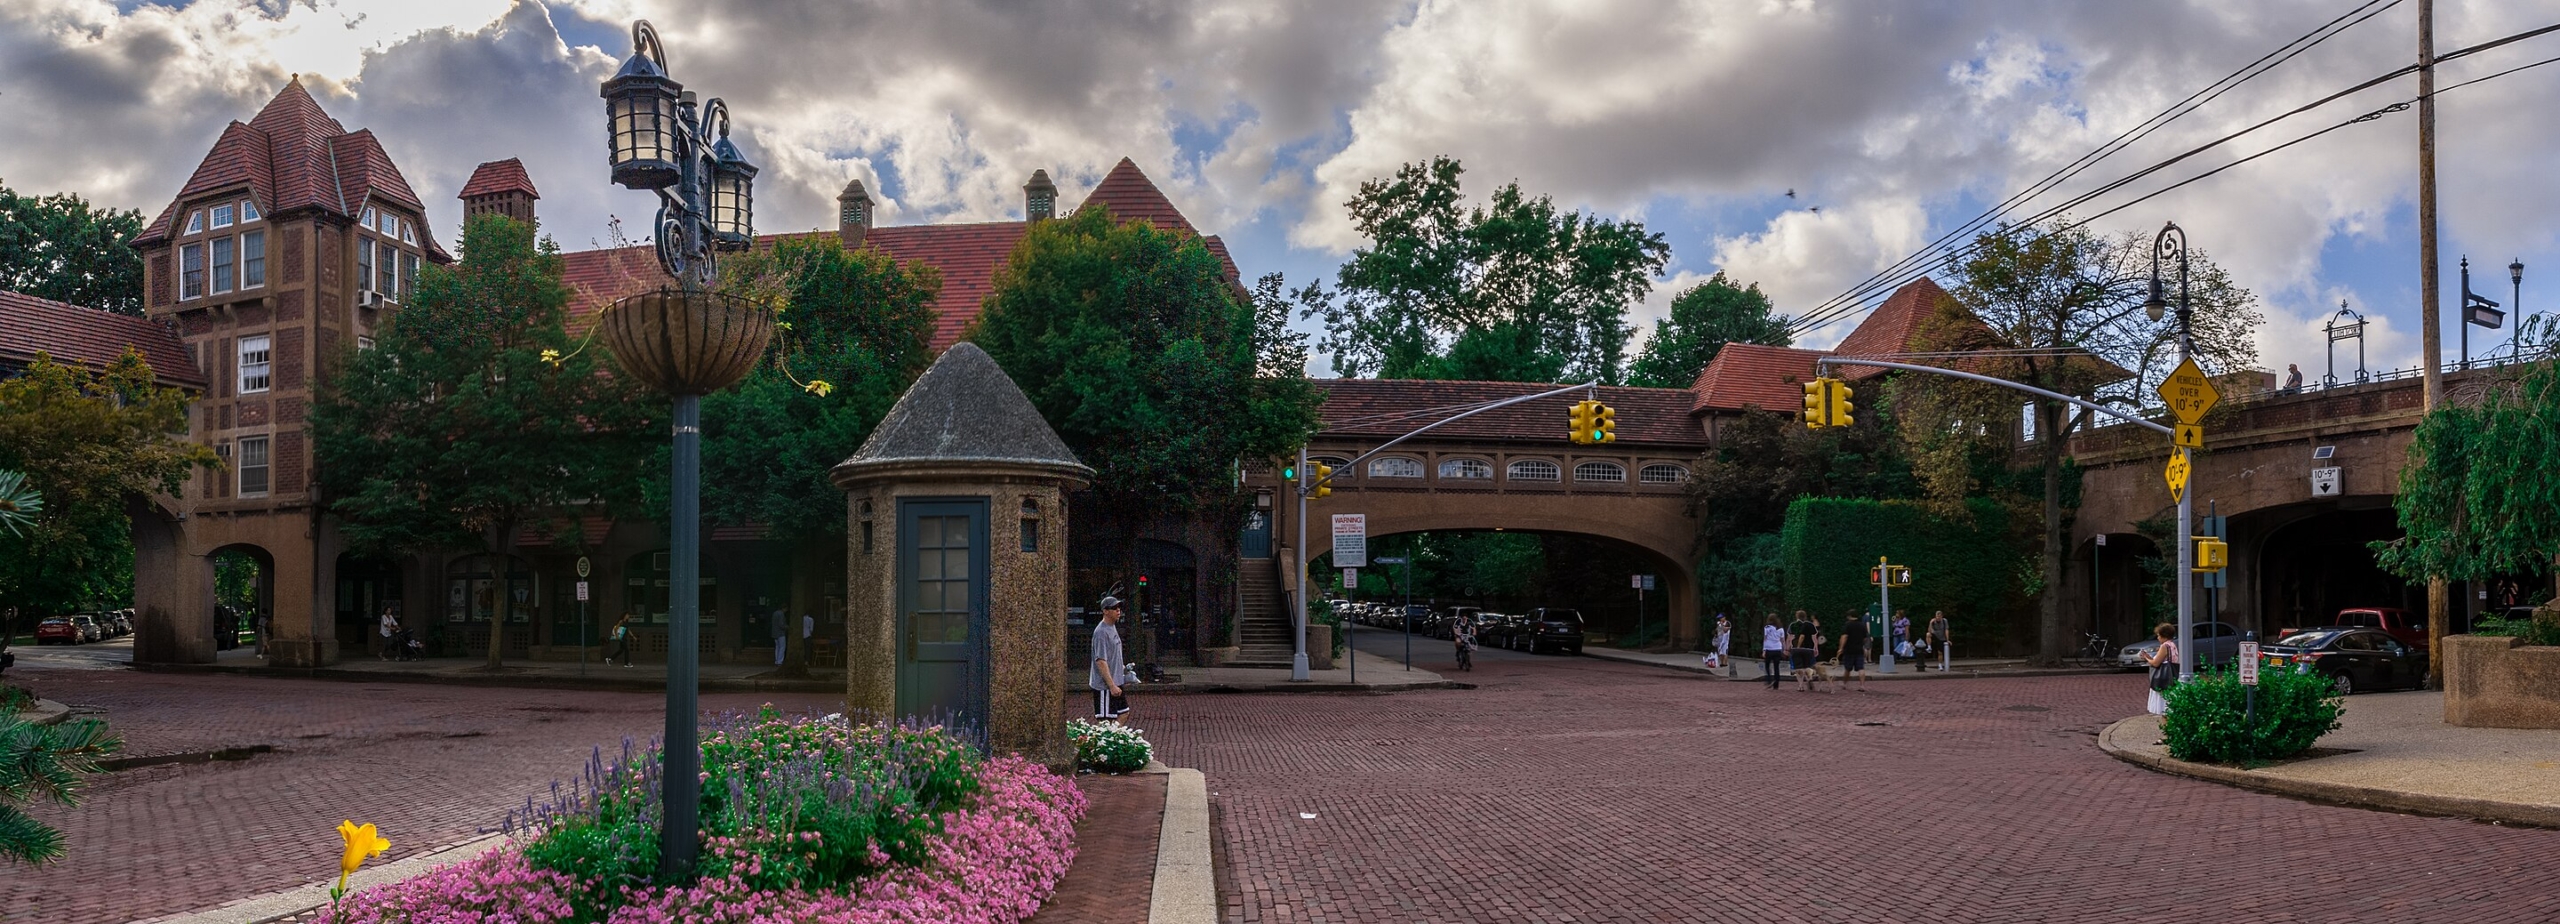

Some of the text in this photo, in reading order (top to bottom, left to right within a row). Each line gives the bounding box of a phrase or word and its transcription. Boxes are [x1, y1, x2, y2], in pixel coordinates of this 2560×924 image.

[2176, 375, 2202, 386] VEHICLES
[2180, 387, 2199, 397] OVER
[2175, 398, 2204, 411] 10'-9"
[2168, 462, 2186, 482] 10'-9"
